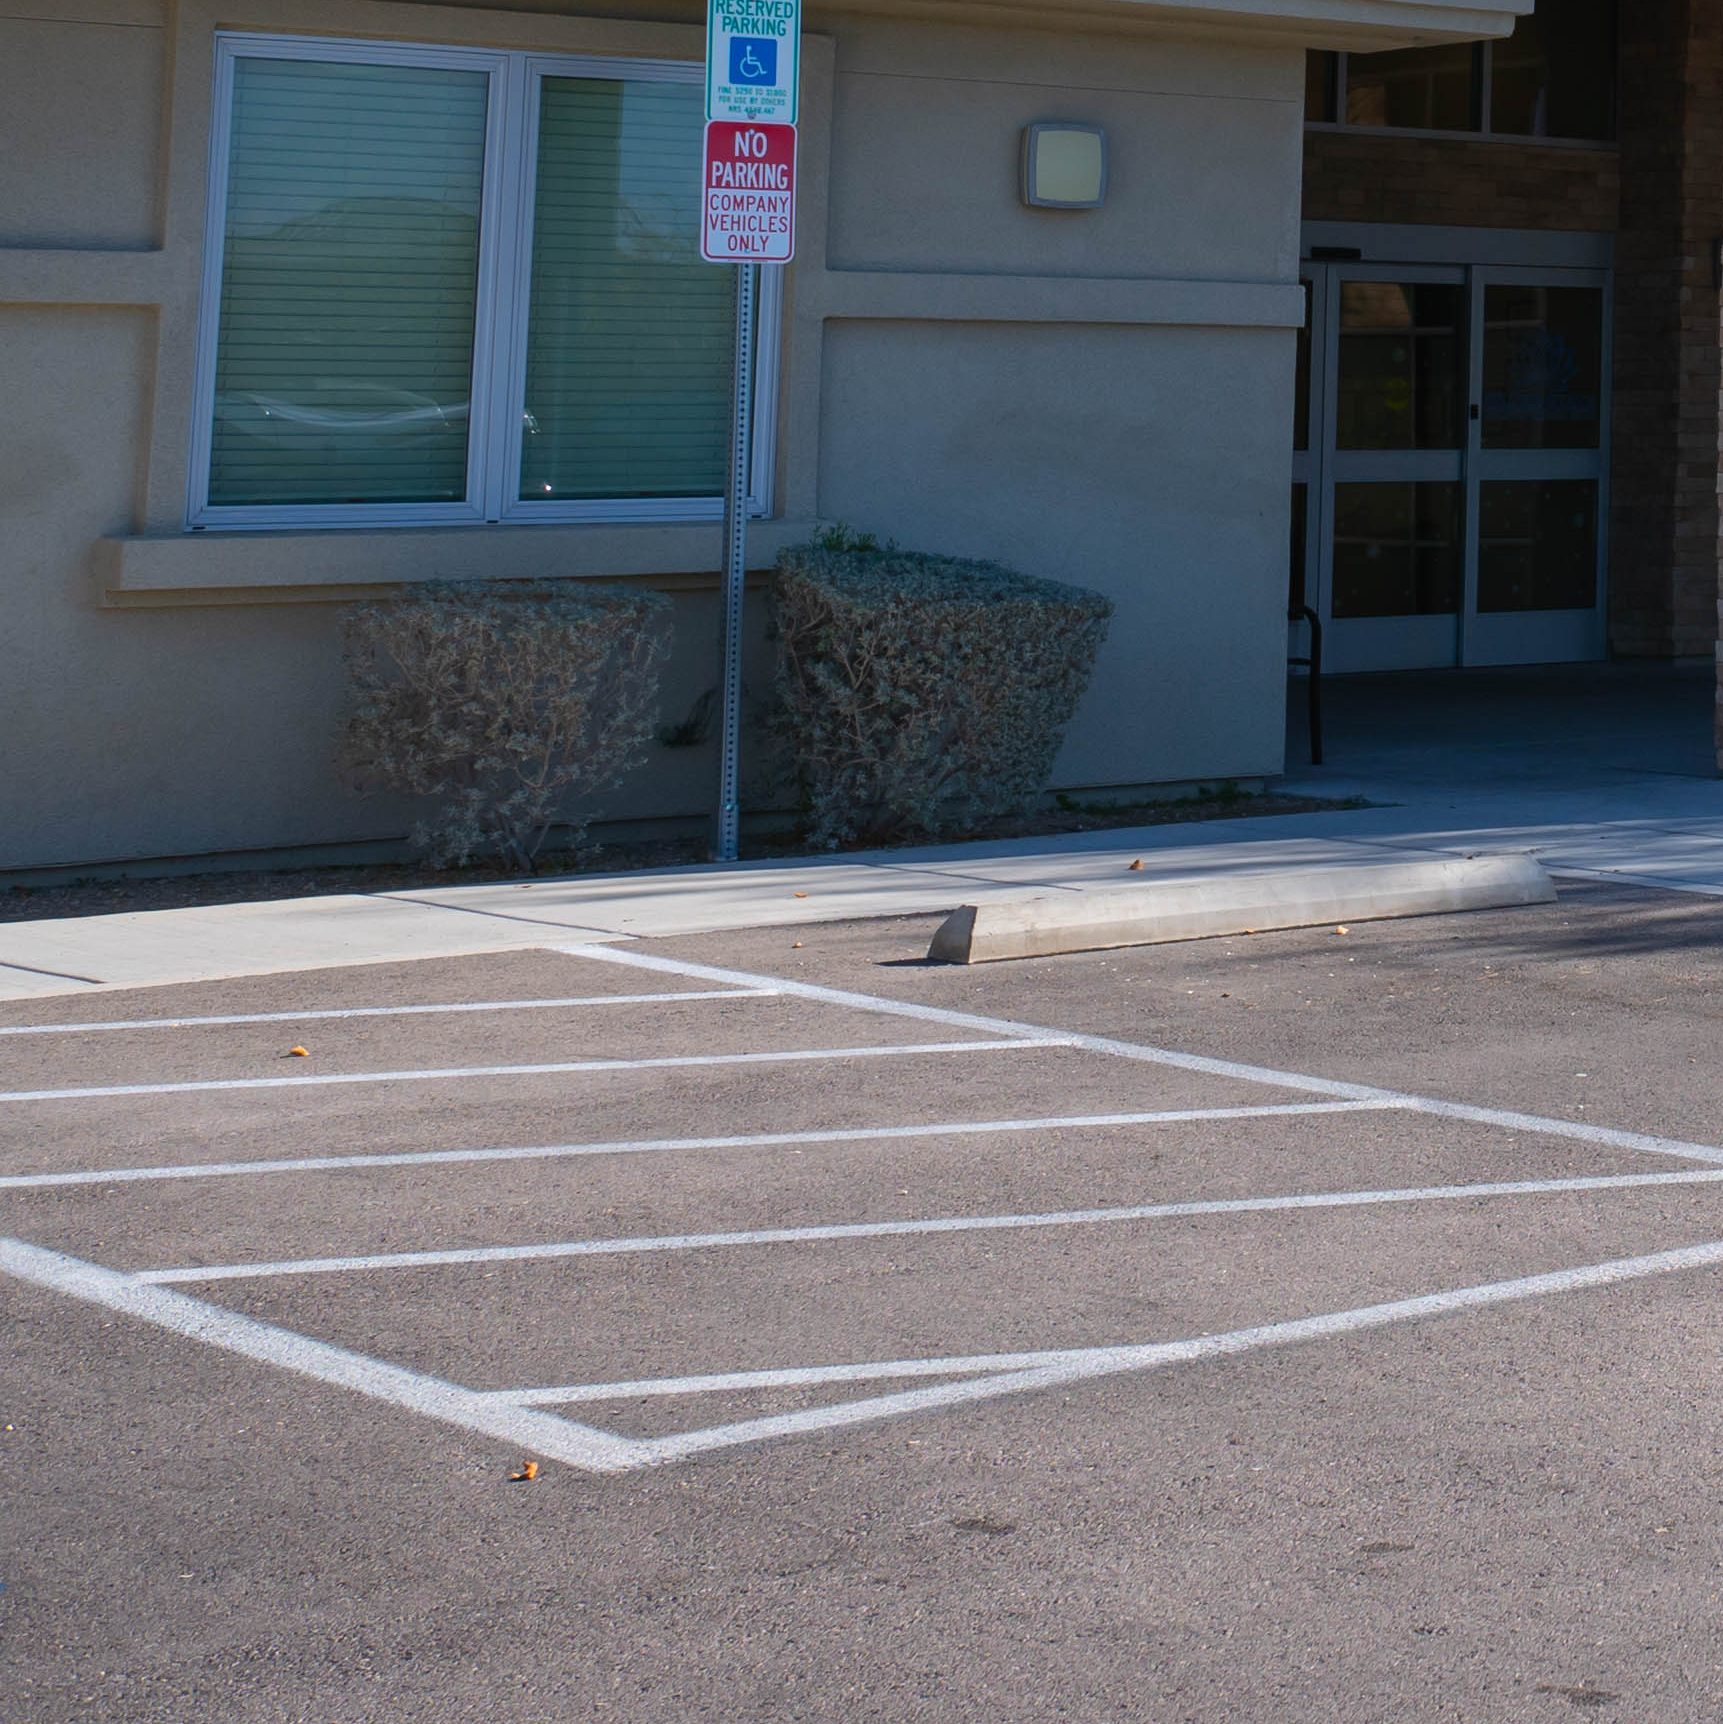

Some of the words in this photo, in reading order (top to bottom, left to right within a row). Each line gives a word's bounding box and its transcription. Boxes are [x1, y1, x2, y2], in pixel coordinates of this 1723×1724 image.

[721, 16, 787, 37] PARKING
[734, 130, 768, 158] NO
[711, 161, 788, 189] PARKING
[709, 194, 789, 214] COMPANY
[709, 214, 788, 233] VEHICLES
[727, 234, 770, 253] ONLY
